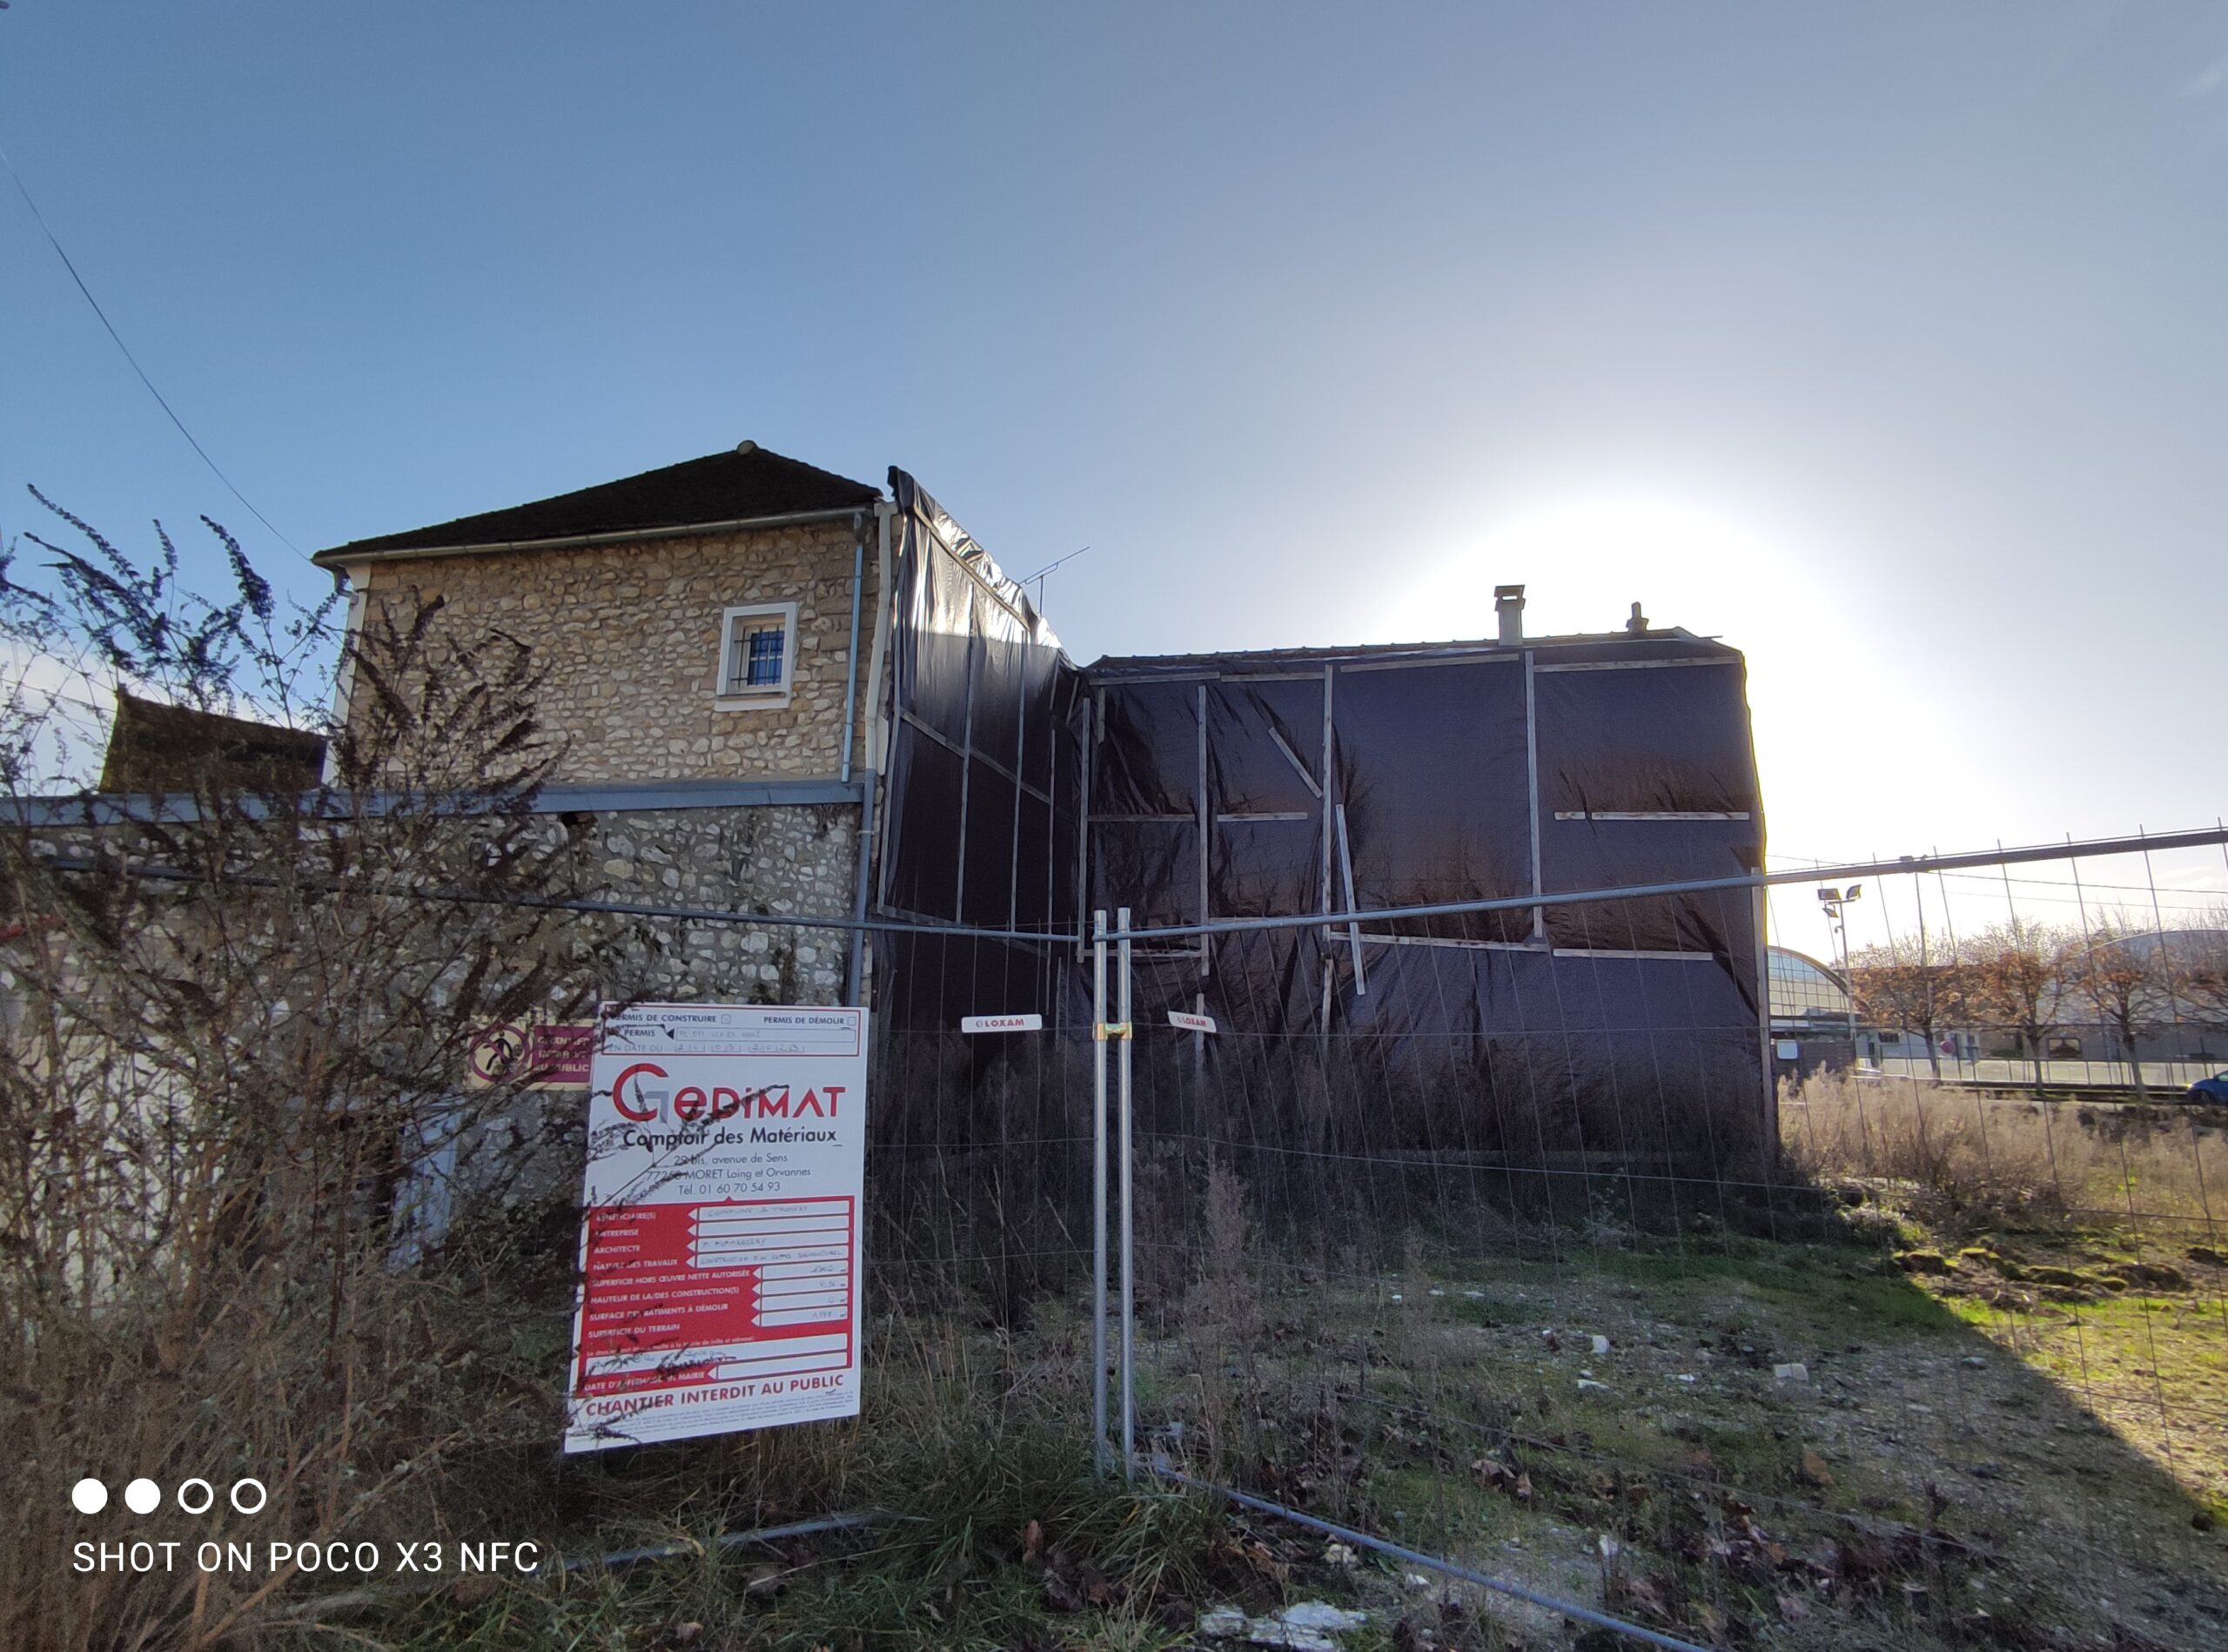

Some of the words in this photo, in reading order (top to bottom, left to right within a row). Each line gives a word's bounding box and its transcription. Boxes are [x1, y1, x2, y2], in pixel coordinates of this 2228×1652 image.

[661, 1014, 716, 1023] CONSTRUIRE
[984, 1018, 1024, 1027] LOXAM
[551, 1063, 589, 1072] UBLIC
[623, 1129, 708, 1151] Comptoir
[714, 1126, 744, 1145] des
[750, 1127, 837, 1144] Matériaux
[750, 1153, 762, 1164] de
[767, 1152, 788, 1163] Sens
[686, 1169, 724, 1179] MORET
[727, 1169, 752, 1181] Loing
[755, 1168, 763, 1178] et
[766, 1167, 811, 1178] Orvannes
[679, 1185, 695, 1195] Tél.
[699, 1185, 712, 1195] 01
[716, 1184, 731, 1194] 60
[734, 1183, 748, 1193] 70
[750, 1182, 763, 1192] 54
[767, 1181, 781, 1192] 93
[594, 1245, 641, 1253] ARCHITECTE
[644, 1259, 678, 1267] TRAVAUX
[688, 1273, 709, 1281] NETTE
[712, 1269, 750, 1279] AUTORISÉE
[591, 1294, 627, 1304] HAUTEUR
[671, 1286, 740, 1298] CONSTRUCTION(S)
[589, 1313, 625, 1321] SURFACE
[627, 1311, 641, 1320] DE
[695, 1302, 728, 1313] DÉMOLIR
[648, 1323, 680, 1333] TERRAIN
[584, 1382, 607, 1391] DATE
[678, 1372, 705, 1380] MAIRIE
[586, 1393, 674, 1416] CHANTIER
[681, 1385, 756, 1404] INTERDIT
[761, 1381, 783, 1395] AU
[789, 1374, 844, 1392] PUBLIC
